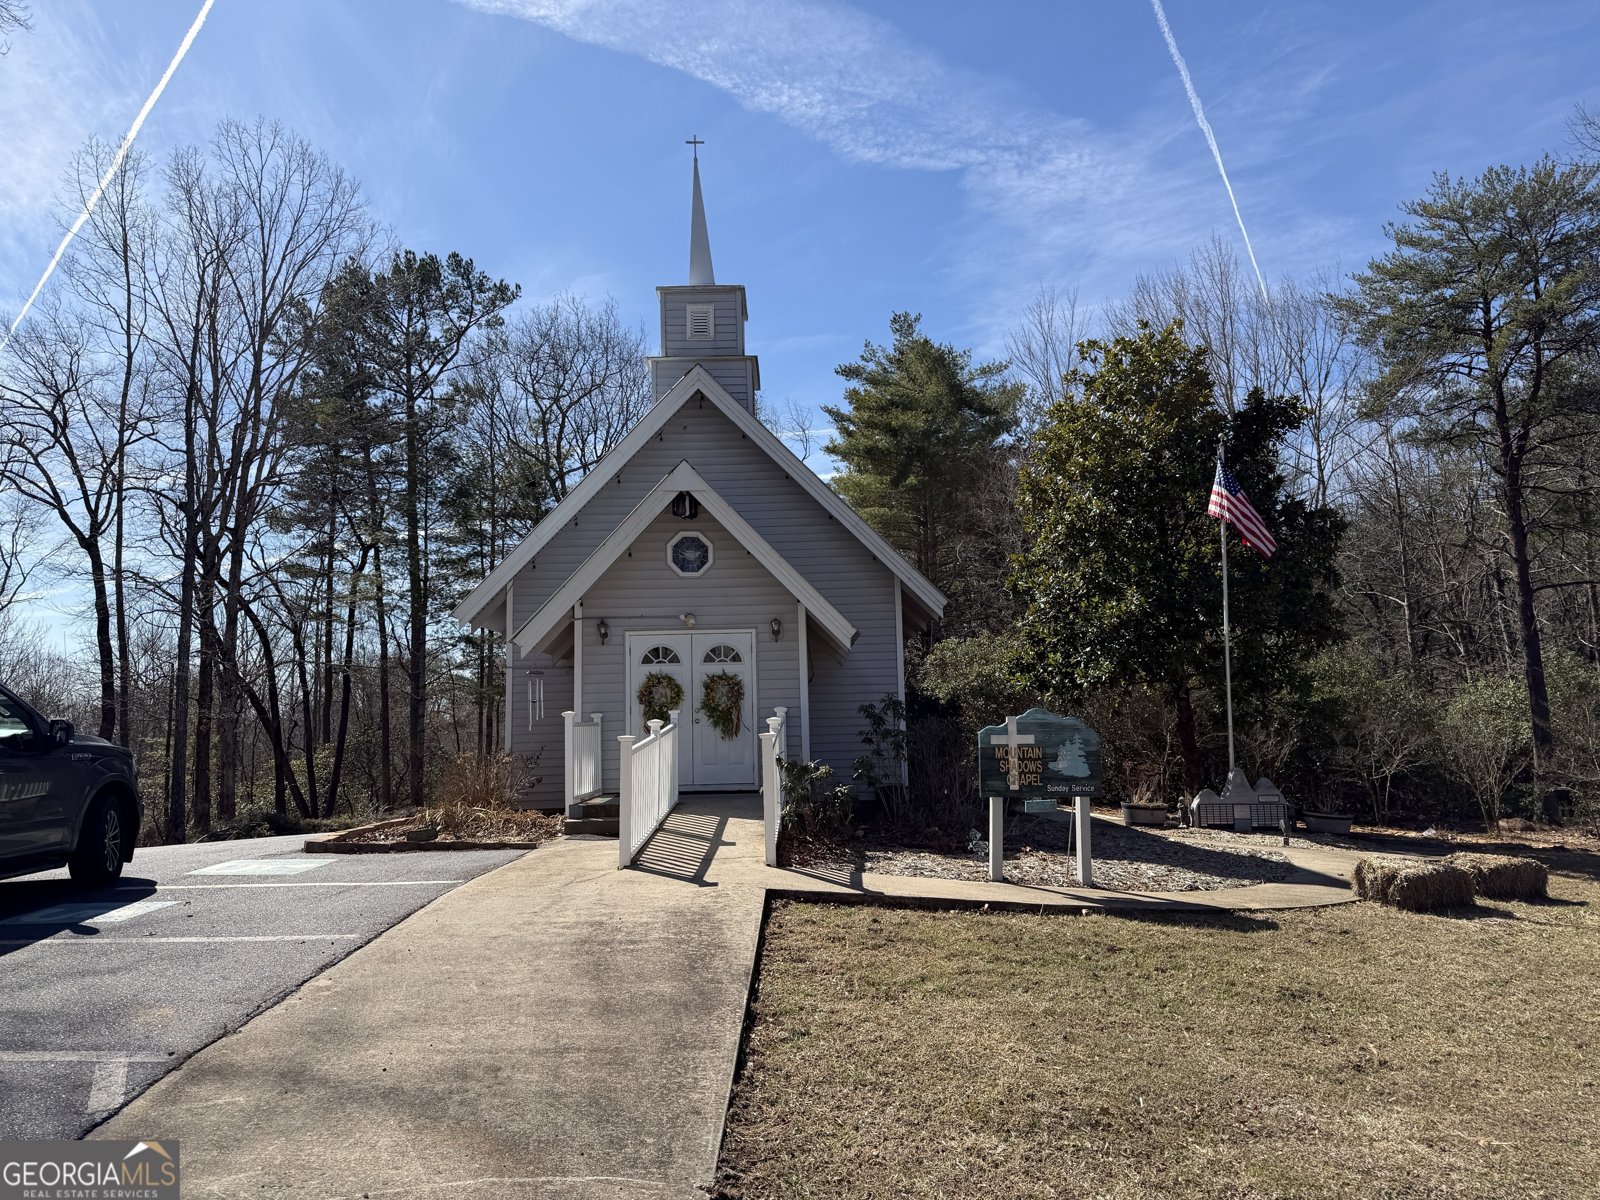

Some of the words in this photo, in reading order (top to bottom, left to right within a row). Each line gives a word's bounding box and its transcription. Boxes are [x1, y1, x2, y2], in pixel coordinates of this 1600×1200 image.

[995, 747, 1042, 759] MOUNTAIN
[1047, 784, 1069, 793] Sunday
[1071, 783, 1095, 792] Service
